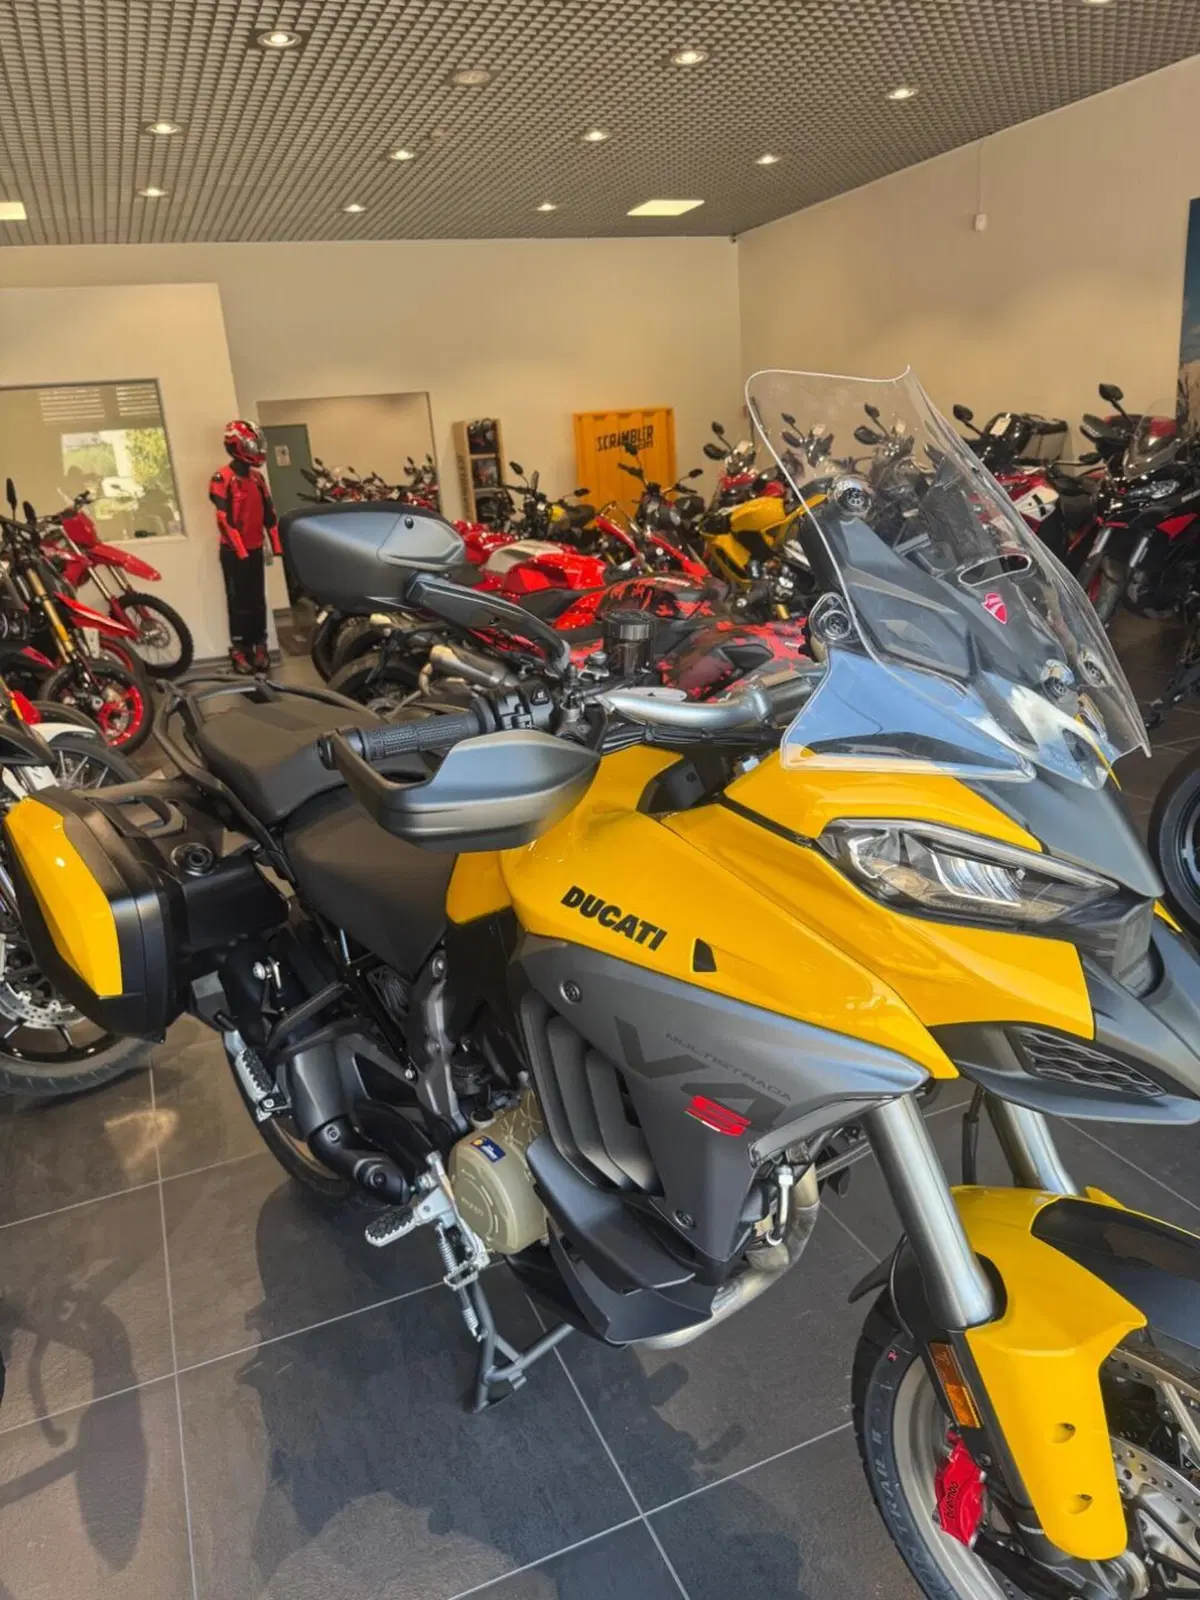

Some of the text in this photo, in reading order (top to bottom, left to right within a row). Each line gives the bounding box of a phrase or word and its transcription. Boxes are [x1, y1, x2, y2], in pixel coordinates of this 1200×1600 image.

[596, 425, 655, 452] SCRAMBLER
[560, 885, 668, 951] DUCATI
[664, 1031, 793, 1102] MULTISTRADA
[874, 1455, 909, 1535] TRAIL
[944, 1481, 960, 1521] brembo
